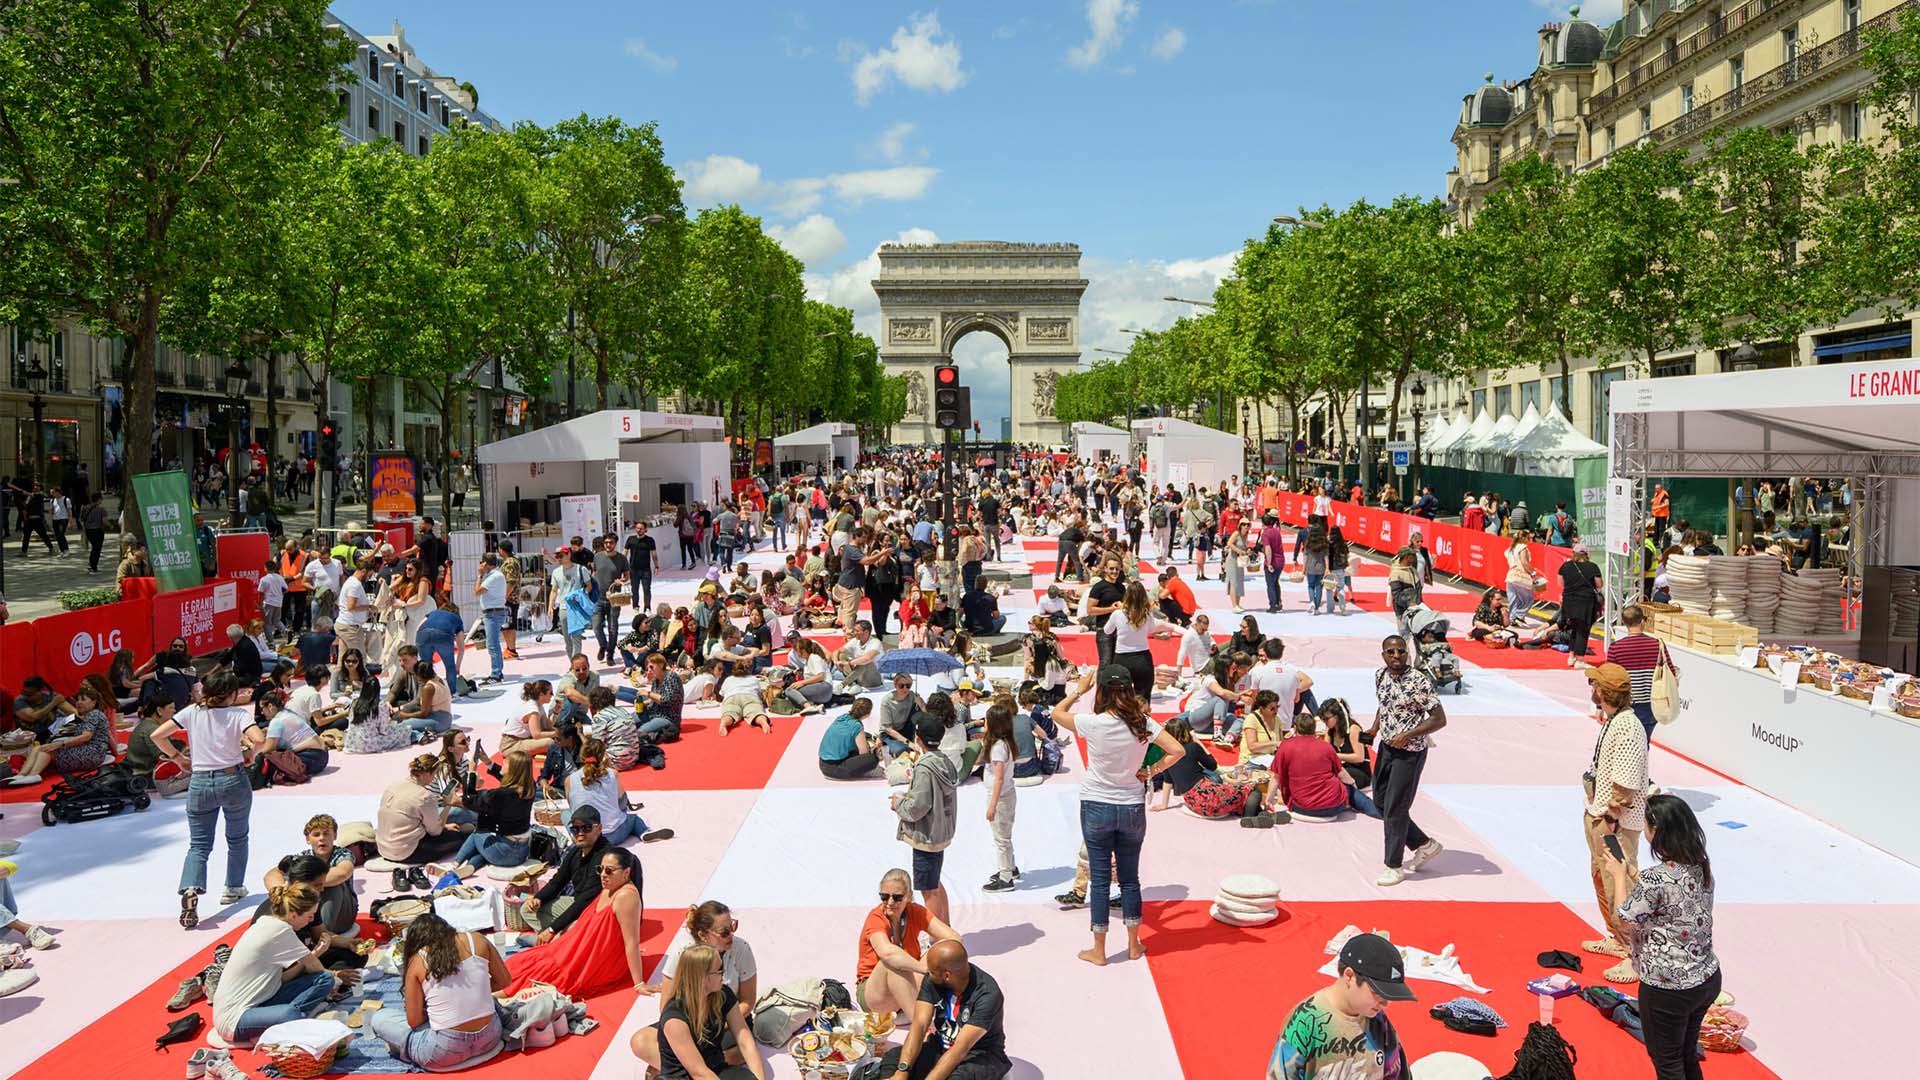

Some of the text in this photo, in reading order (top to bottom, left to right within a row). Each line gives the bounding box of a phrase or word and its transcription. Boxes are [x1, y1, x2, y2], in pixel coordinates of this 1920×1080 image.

[1850, 373, 1867, 398] LE
[623, 416, 630, 432] 5
[1158, 421, 1163, 430] 6
[1443, 540, 1452, 555] LG
[181, 596, 214, 616] LE GRAND
[181, 619, 214, 638] DES CHAMPS
[98, 629, 121, 655] LG
